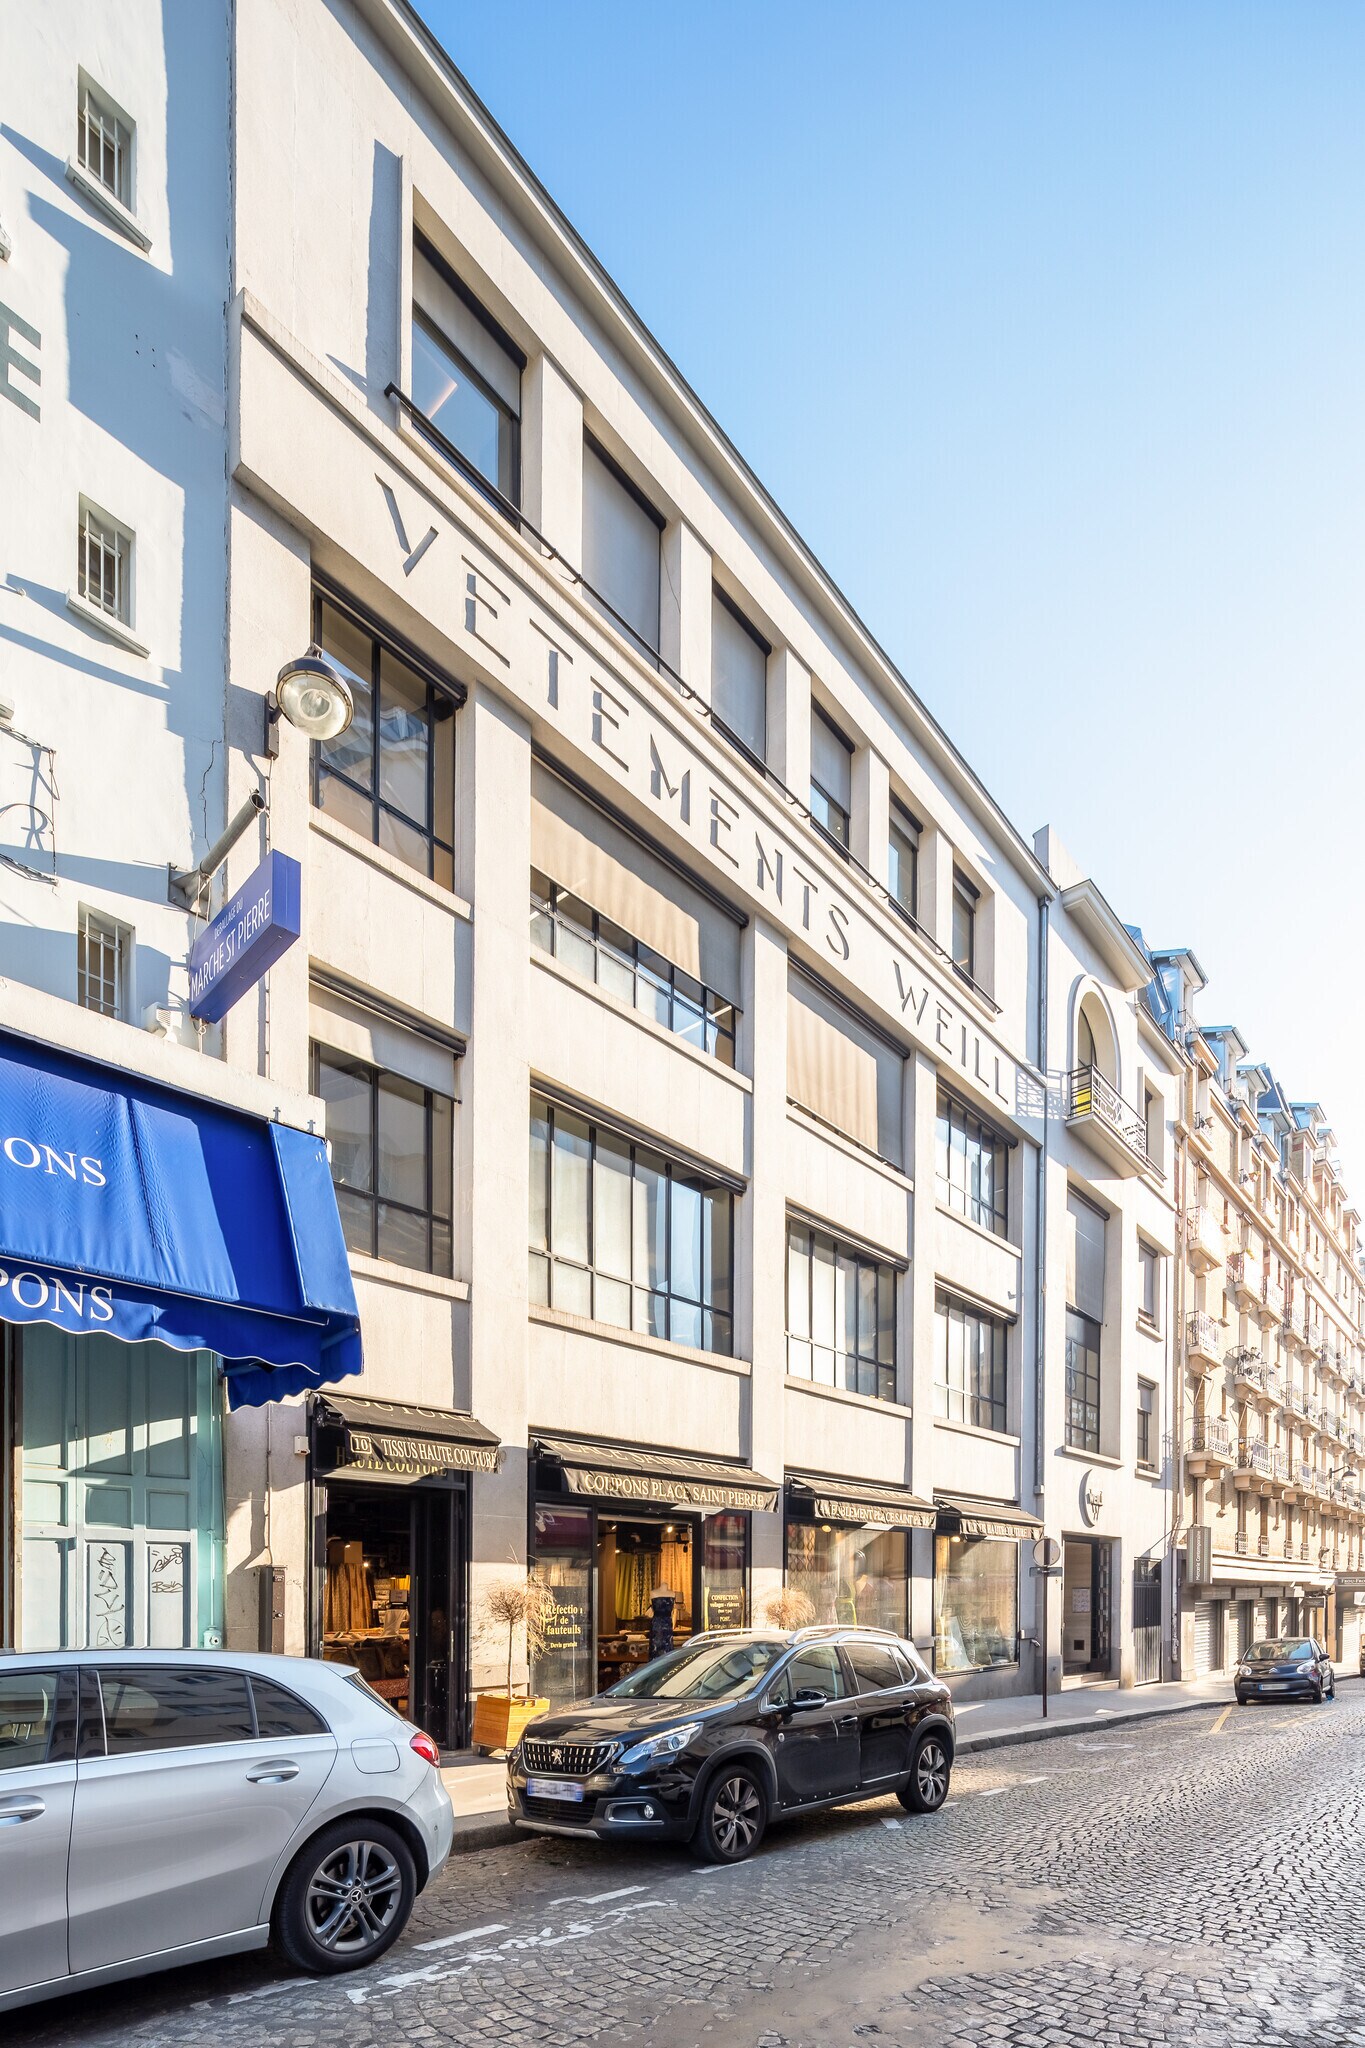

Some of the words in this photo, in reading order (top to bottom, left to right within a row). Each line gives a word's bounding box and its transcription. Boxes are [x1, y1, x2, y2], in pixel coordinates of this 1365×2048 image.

[374, 472, 849, 961] VETEMENTS
[893, 960, 1008, 1105] WEILL
[226, 929, 236, 963] ST
[238, 889, 270, 950] PIERRE
[355, 1437, 368, 1451] 10
[381, 1438, 418, 1459] TISSUS
[418, 1443, 454, 1463] HAUTE
[454, 1449, 497, 1469] COUTURE
[585, 1474, 649, 1495] COUPONS
[652, 1481, 690, 1500] PLACE
[693, 1486, 726, 1504] SAINT
[728, 1490, 764, 1507] PIERRE
[546, 1624, 582, 1635] fauteuils
[559, 1615, 569, 1625] de
